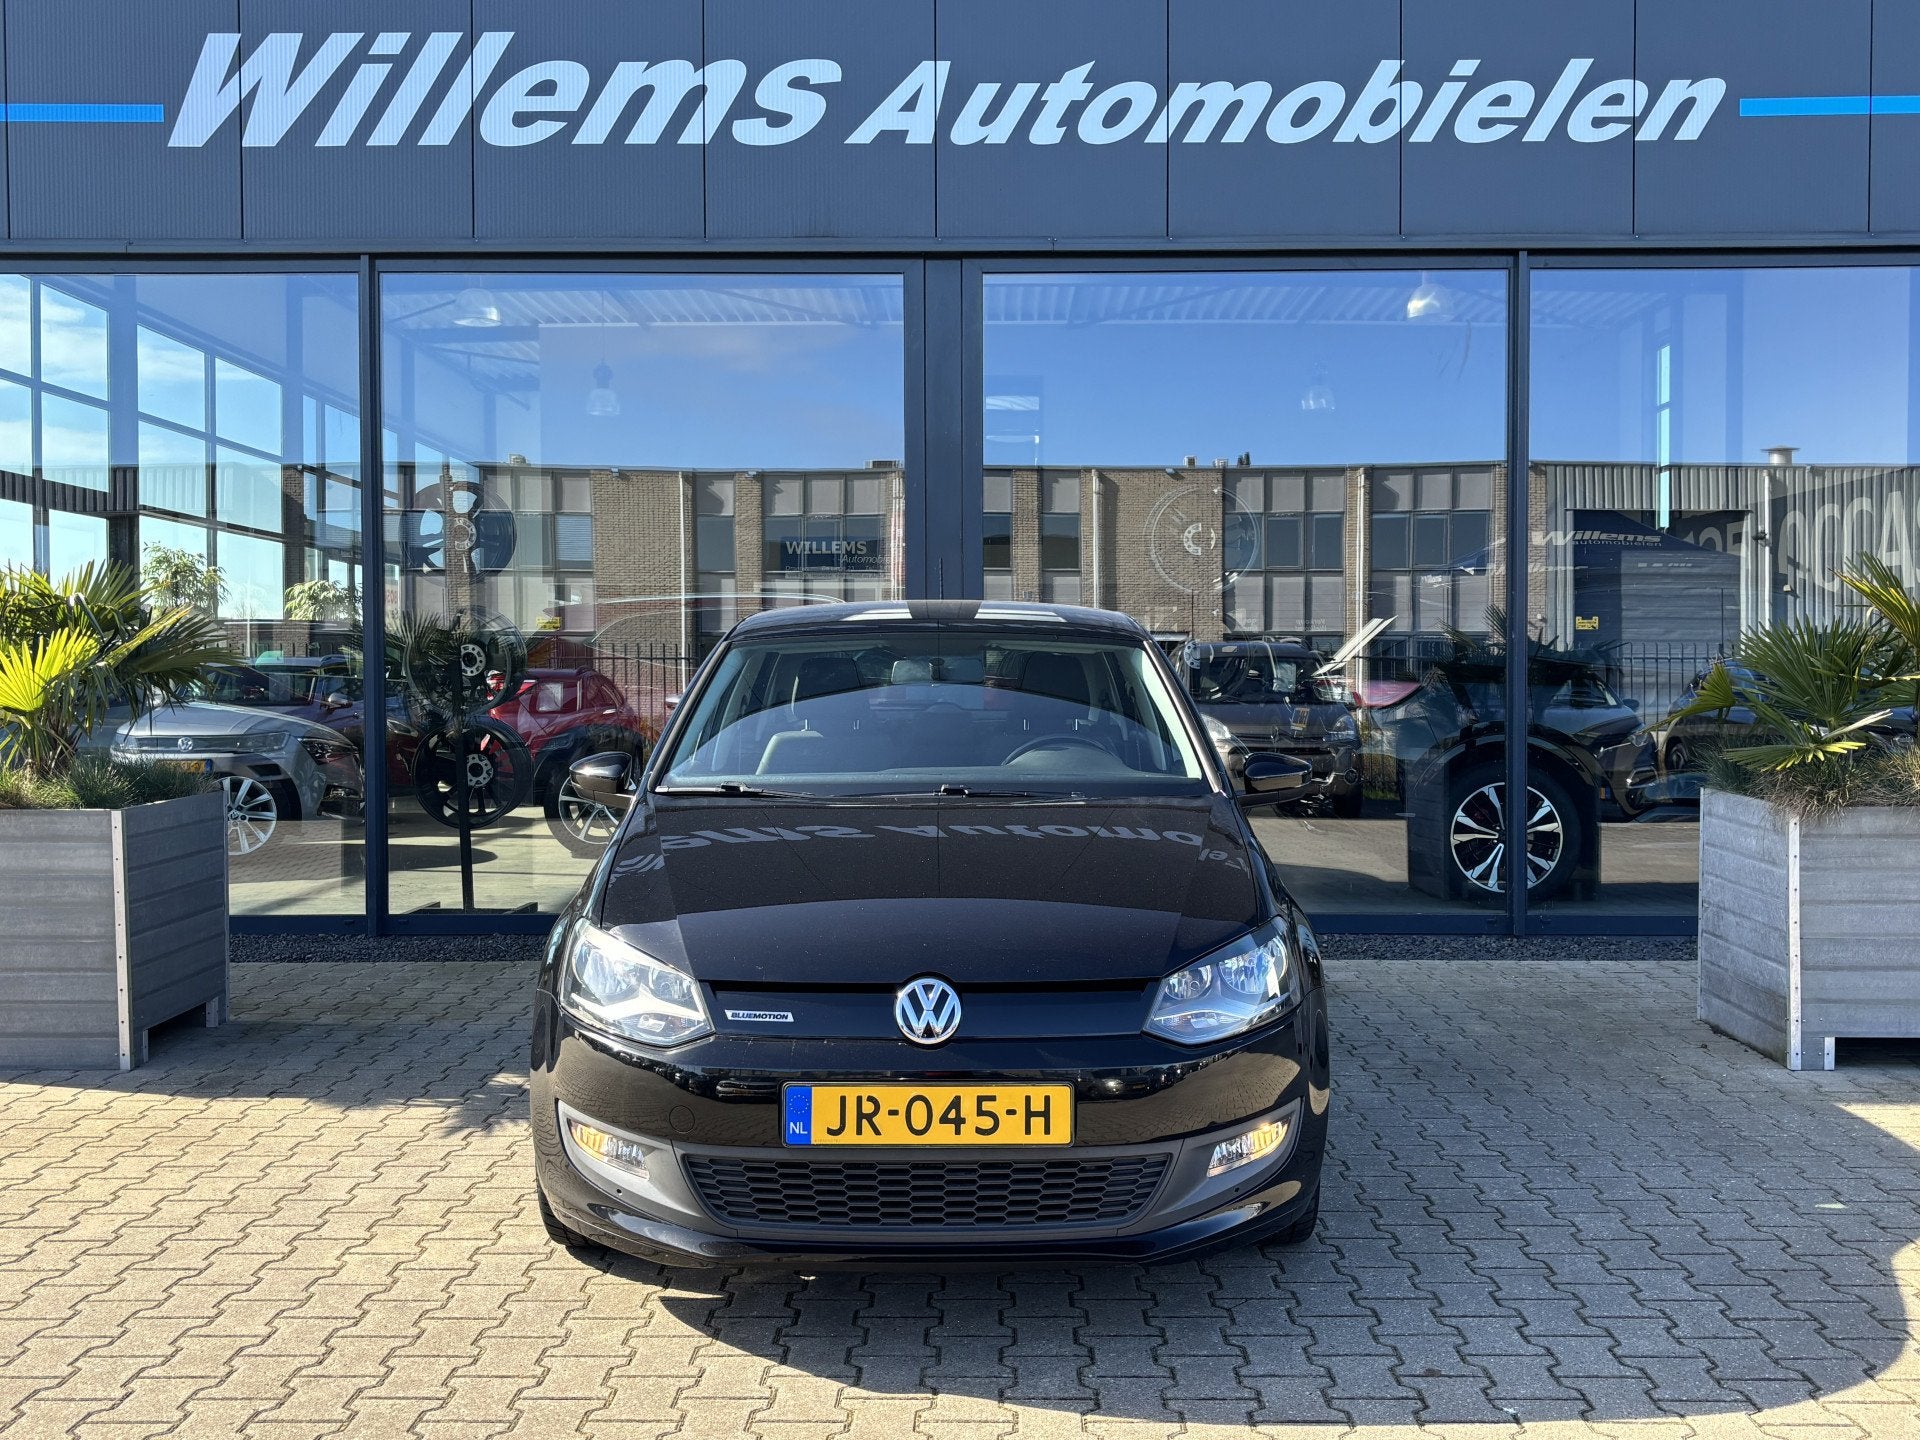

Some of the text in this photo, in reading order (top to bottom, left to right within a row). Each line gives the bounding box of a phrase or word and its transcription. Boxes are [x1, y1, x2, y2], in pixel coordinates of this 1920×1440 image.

[167, 31, 1727, 147] Willems Automobielen
[1531, 530, 1662, 546] Willems
[1777, 490, 1920, 594] OCCA
[785, 541, 867, 555] WILLEMS
[731, 1011, 789, 1020] BLUEMOTION
[826, 1094, 1051, 1137] JR-045-H
[789, 1121, 808, 1135] NL
